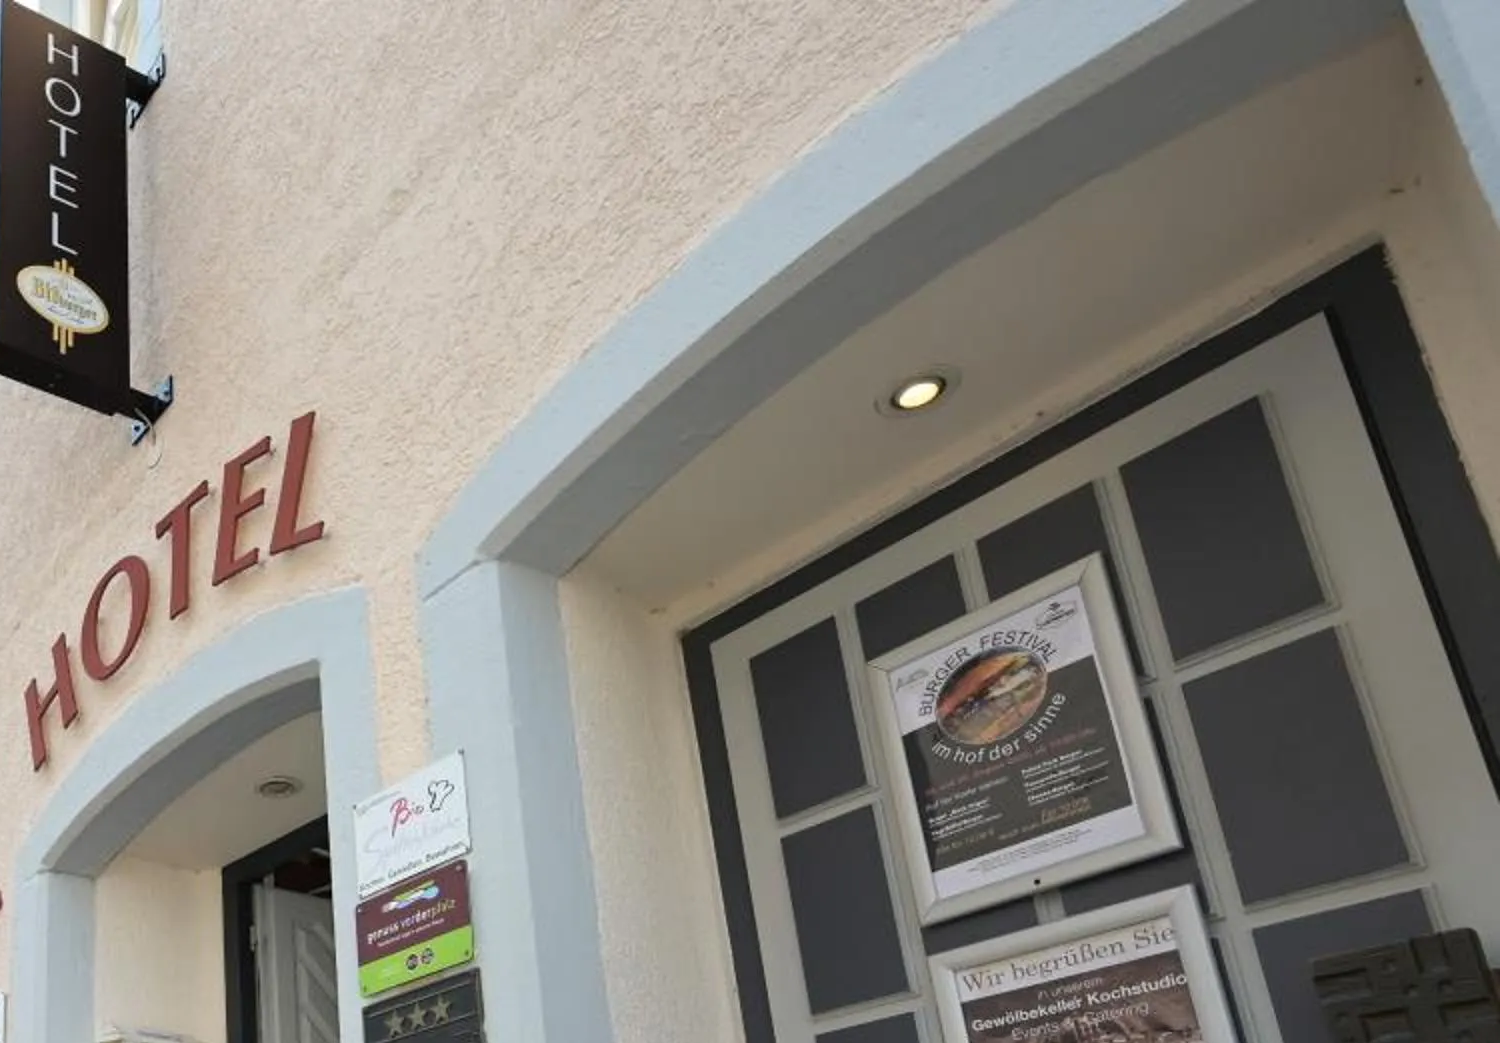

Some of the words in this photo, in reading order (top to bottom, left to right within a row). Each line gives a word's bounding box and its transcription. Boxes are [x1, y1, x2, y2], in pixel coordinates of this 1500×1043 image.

[46, 33, 80, 256] HOTEL
[24, 411, 325, 773] HOTEL
[918, 646, 971, 718] BURGER
[979, 630, 1058, 664] FESTIVAL
[952, 750, 986, 766] hof
[988, 740, 1022, 762] der
[1024, 692, 1067, 744] sinne
[963, 971, 1006, 993] Wir
[1011, 942, 1126, 984] begrüßen
[1134, 925, 1177, 950] Sie
[971, 997, 1084, 1032] Gewölbekeller
[1088, 973, 1188, 1007] Kochstudio
[1012, 1020, 1060, 1041] Events
